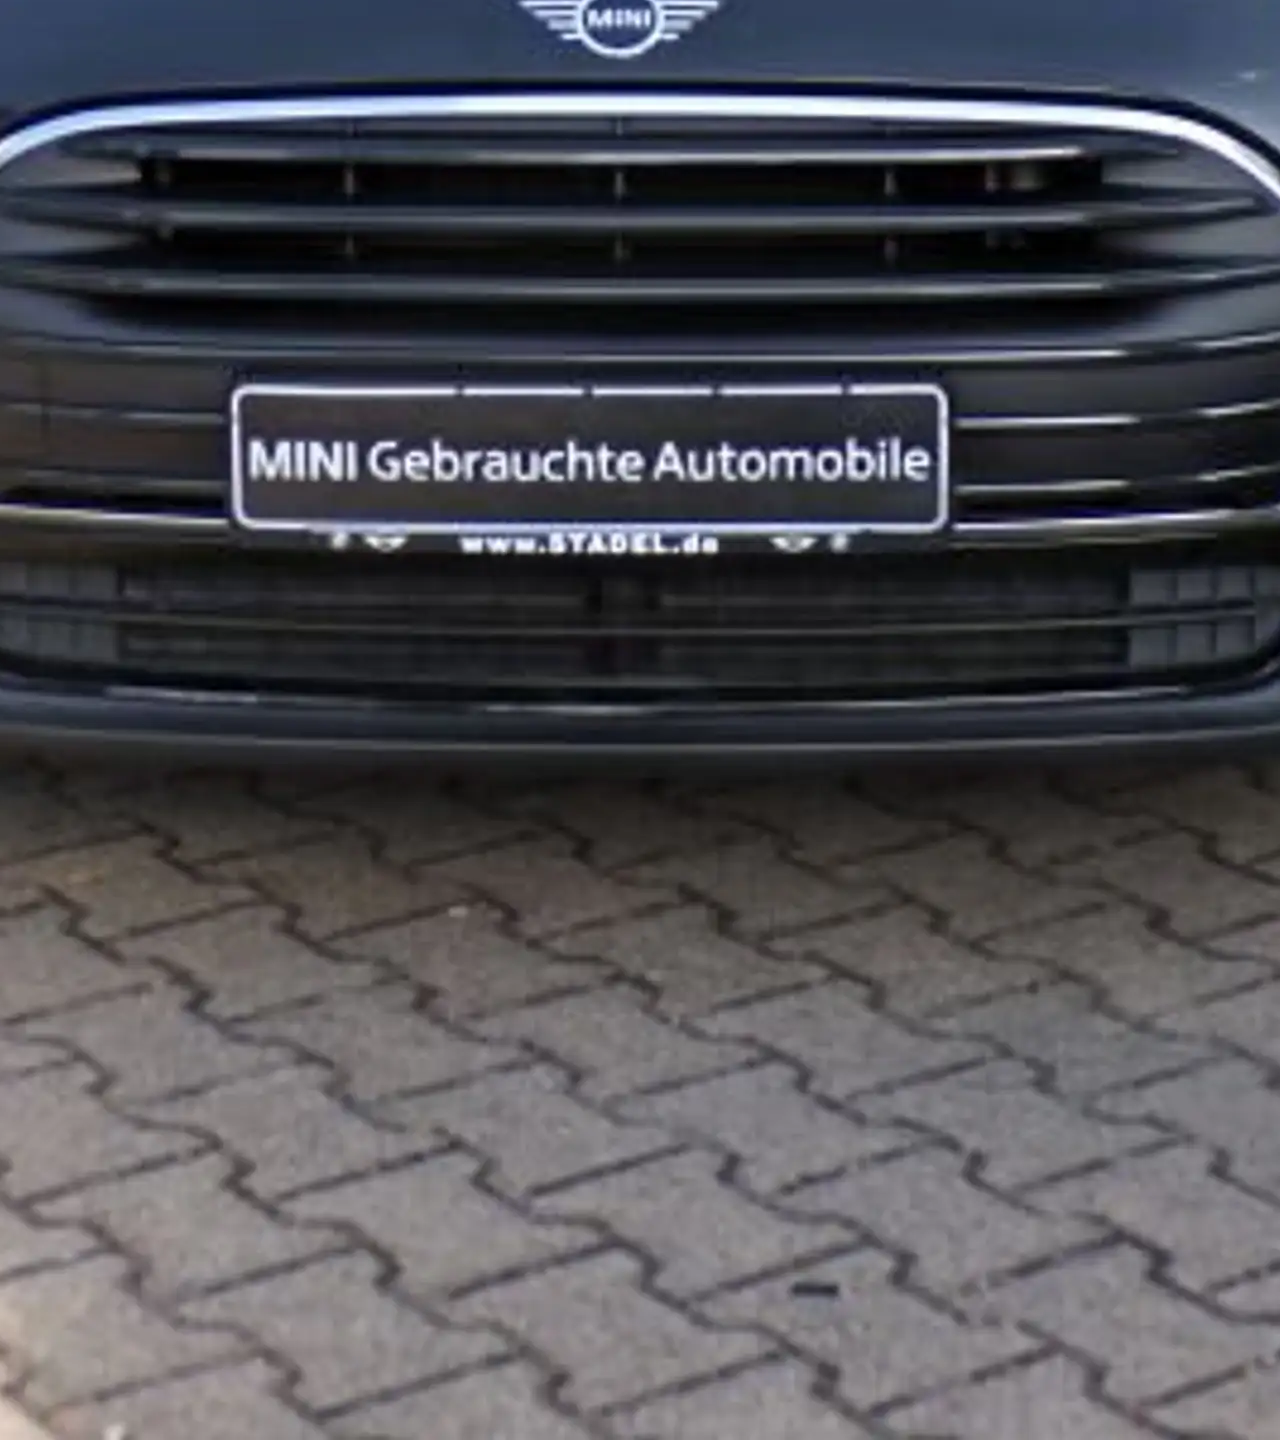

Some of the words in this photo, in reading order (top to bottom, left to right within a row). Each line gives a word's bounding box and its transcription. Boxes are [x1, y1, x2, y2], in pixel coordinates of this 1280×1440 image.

[587, 8, 651, 29] MINI
[249, 440, 358, 482] MINI
[368, 437, 645, 482] Gebrauchte
[653, 436, 930, 482] Automobile
